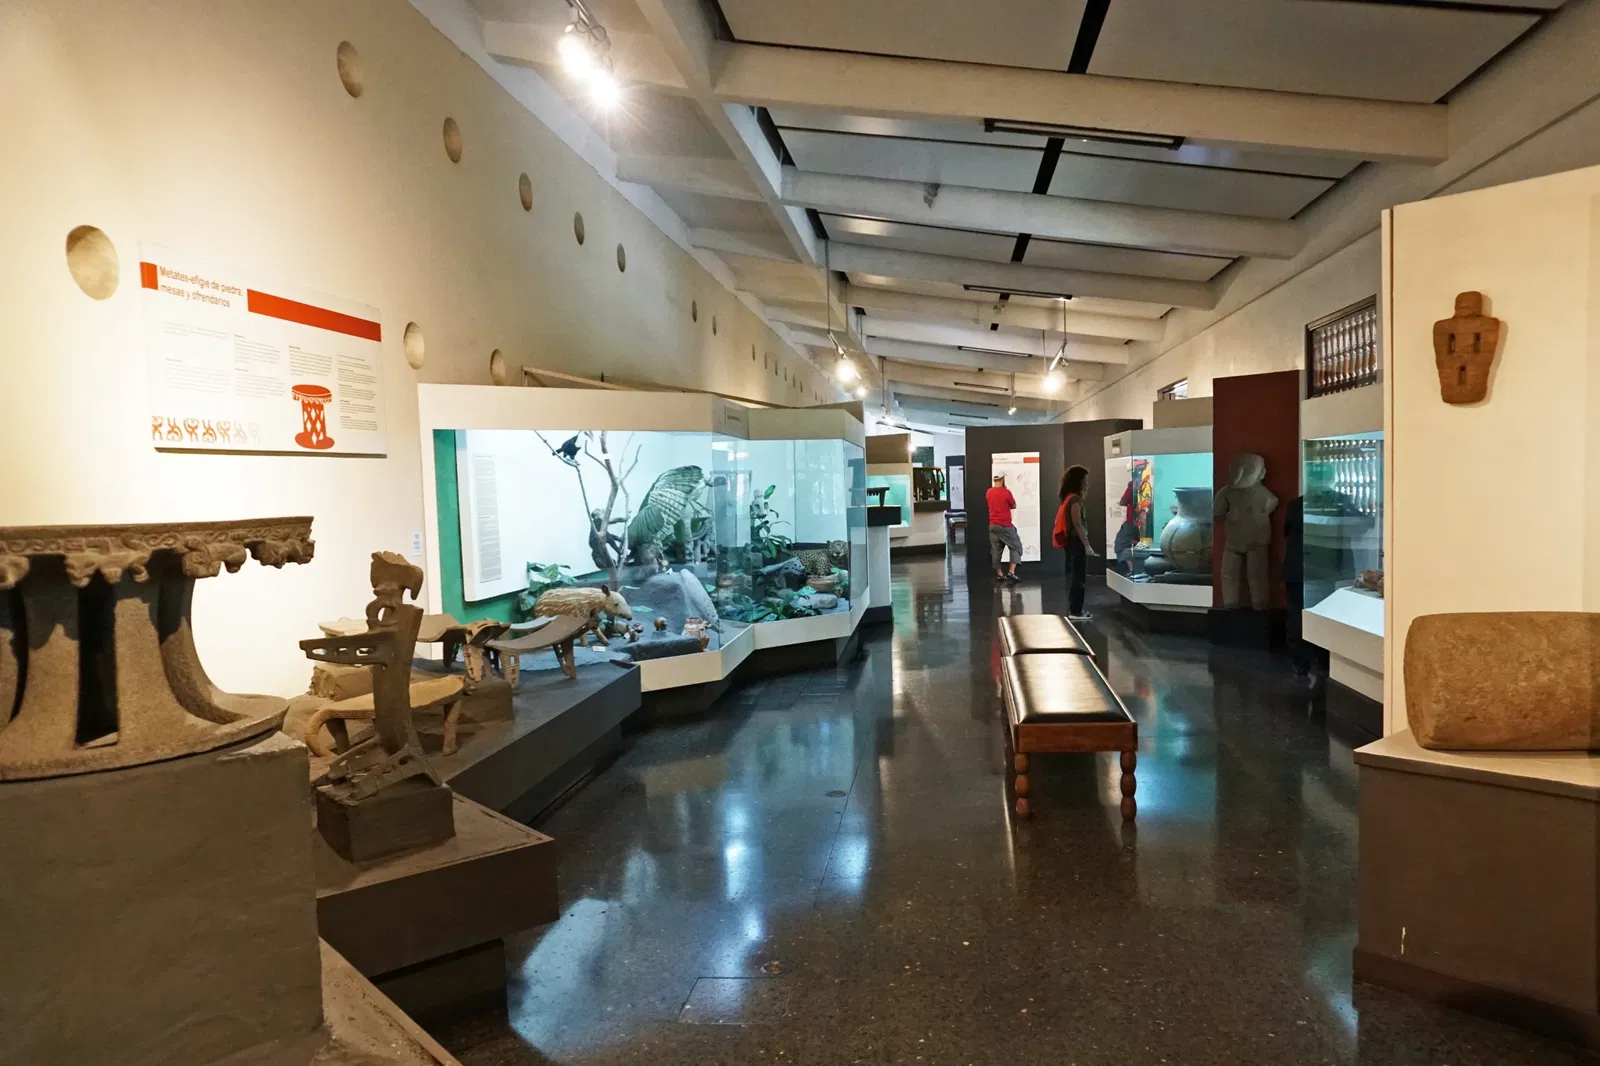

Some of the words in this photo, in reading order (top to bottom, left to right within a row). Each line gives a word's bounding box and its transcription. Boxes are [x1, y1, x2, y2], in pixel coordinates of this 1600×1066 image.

[159, 266, 210, 289] Metates-efigie
[211, 280, 220, 290] de
[160, 284, 184, 297] mesas
[191, 290, 230, 308] ofrendarios
